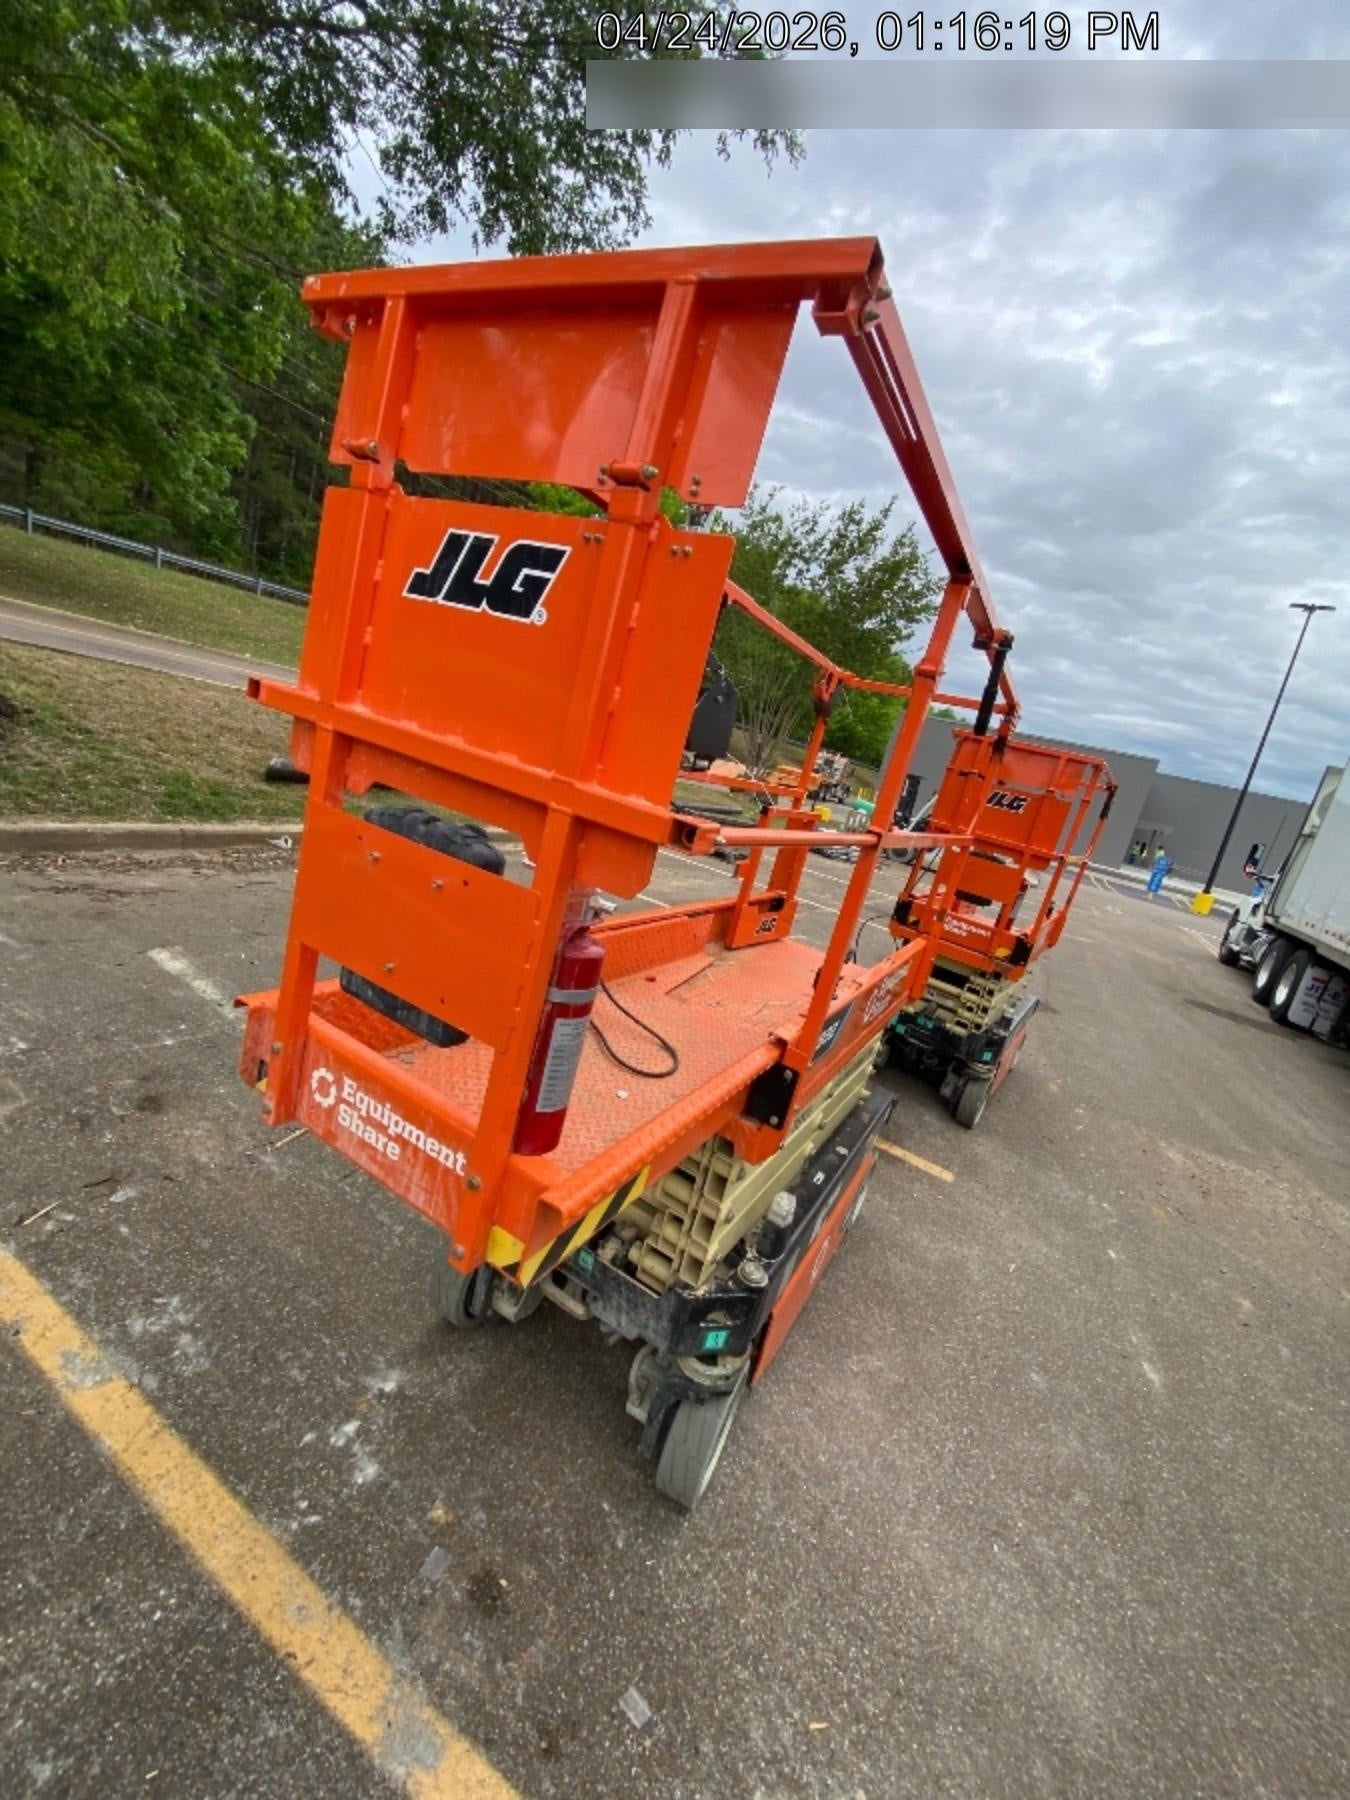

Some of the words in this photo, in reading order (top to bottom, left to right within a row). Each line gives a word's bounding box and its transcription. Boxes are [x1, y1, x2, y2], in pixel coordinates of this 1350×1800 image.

[402, 528, 572, 624] JLG
[986, 790, 1031, 814] JLG
[337, 1103, 400, 1161] Share
[341, 1075, 467, 1176] Equipment
